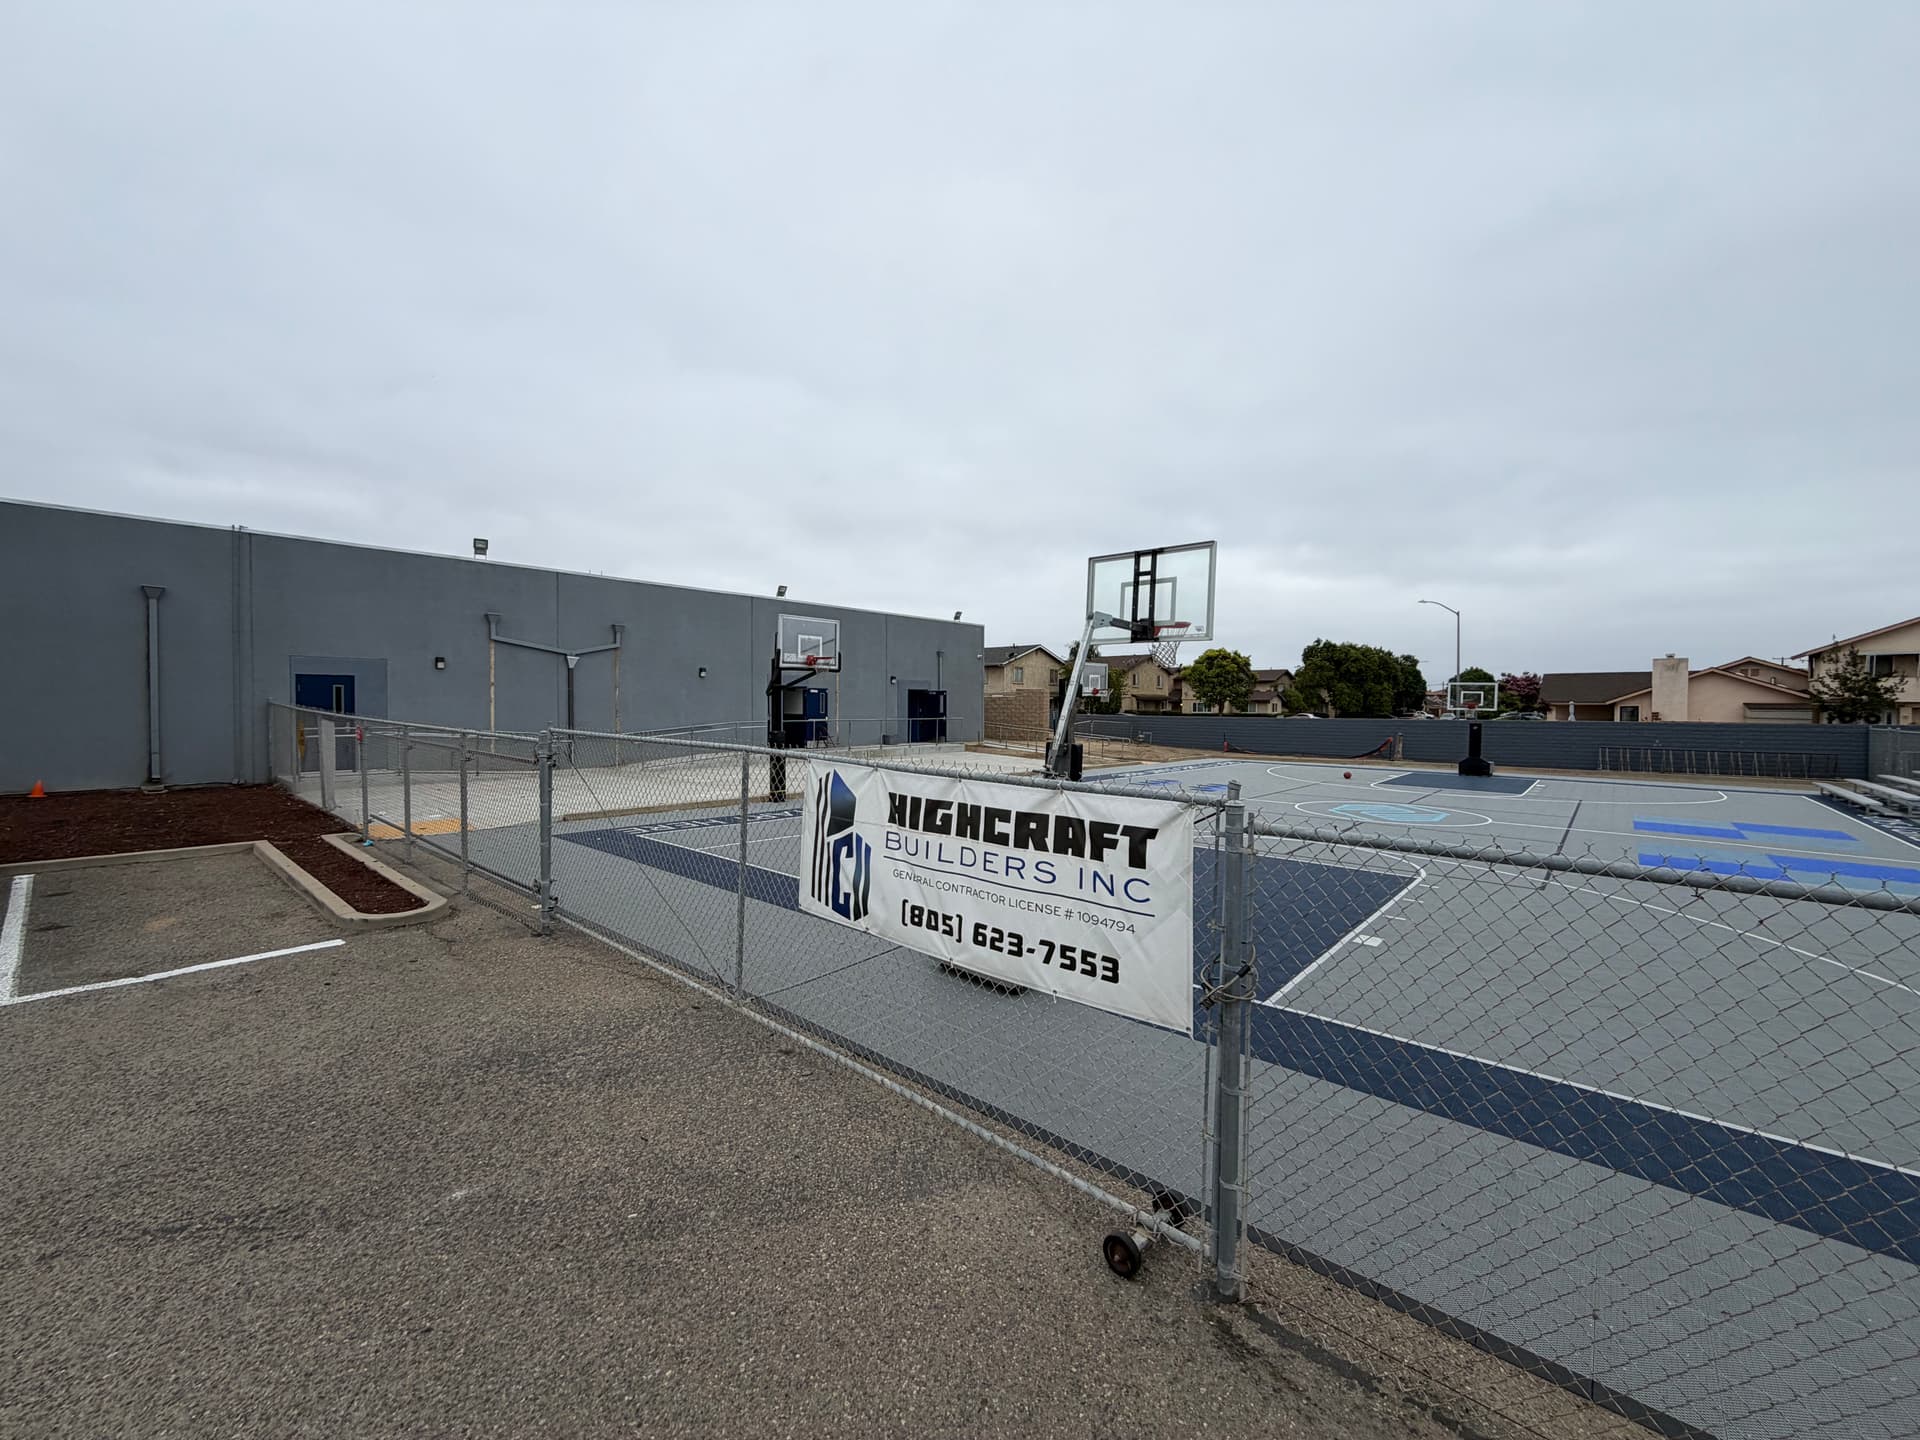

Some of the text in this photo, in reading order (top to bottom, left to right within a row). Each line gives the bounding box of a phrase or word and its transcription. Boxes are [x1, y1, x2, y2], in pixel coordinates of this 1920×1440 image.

[885, 831, 1150, 903] BUILDERS INC
[887, 792, 1159, 870] HIGHCRAFT
[901, 899, 1120, 984] (805) 623-7553
[935, 880, 1006, 906] CONTRACTOR
[1008, 897, 1062, 917] LICENSE
[1064, 908, 1075, 921] #
[1077, 911, 1136, 935] 1094794
